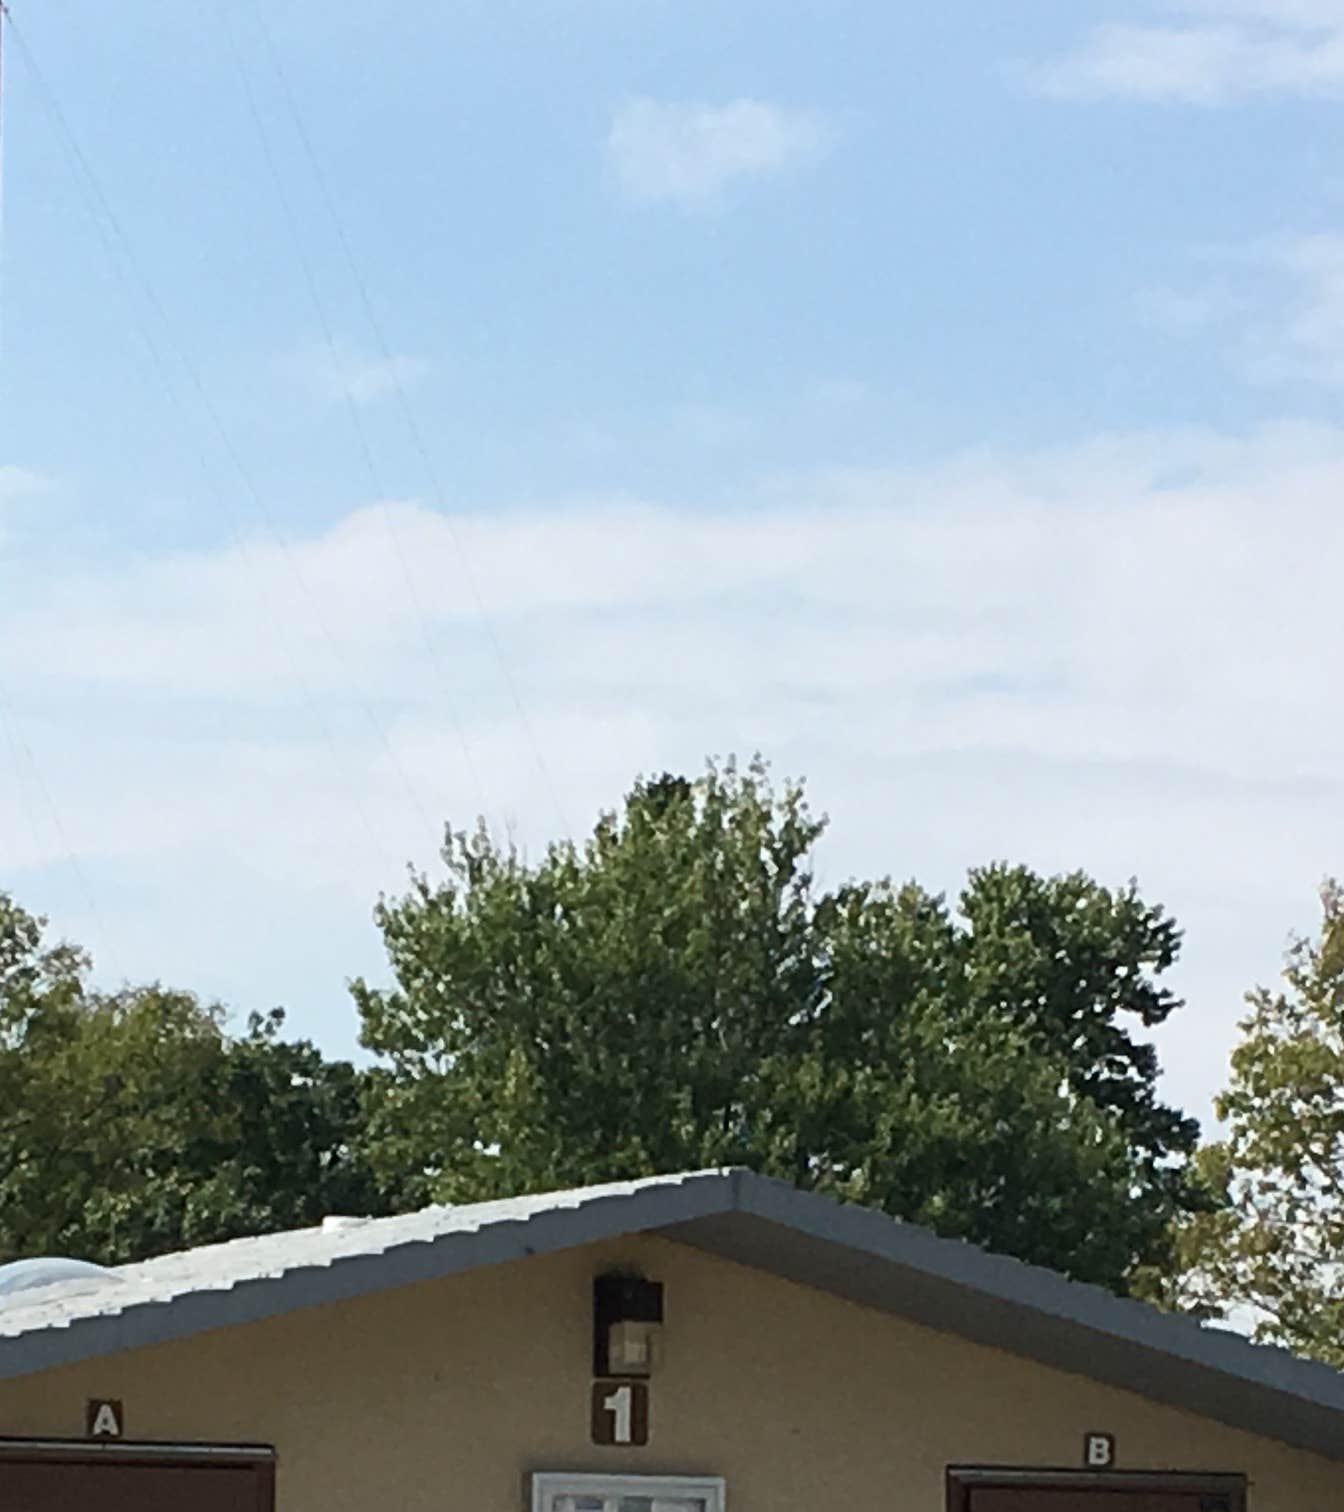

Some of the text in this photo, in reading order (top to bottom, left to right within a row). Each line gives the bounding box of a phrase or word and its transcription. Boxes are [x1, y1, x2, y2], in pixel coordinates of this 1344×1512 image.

[93, 1403, 120, 1436] A
[603, 1386, 632, 1443] 1
[1087, 1436, 1112, 1465] B
